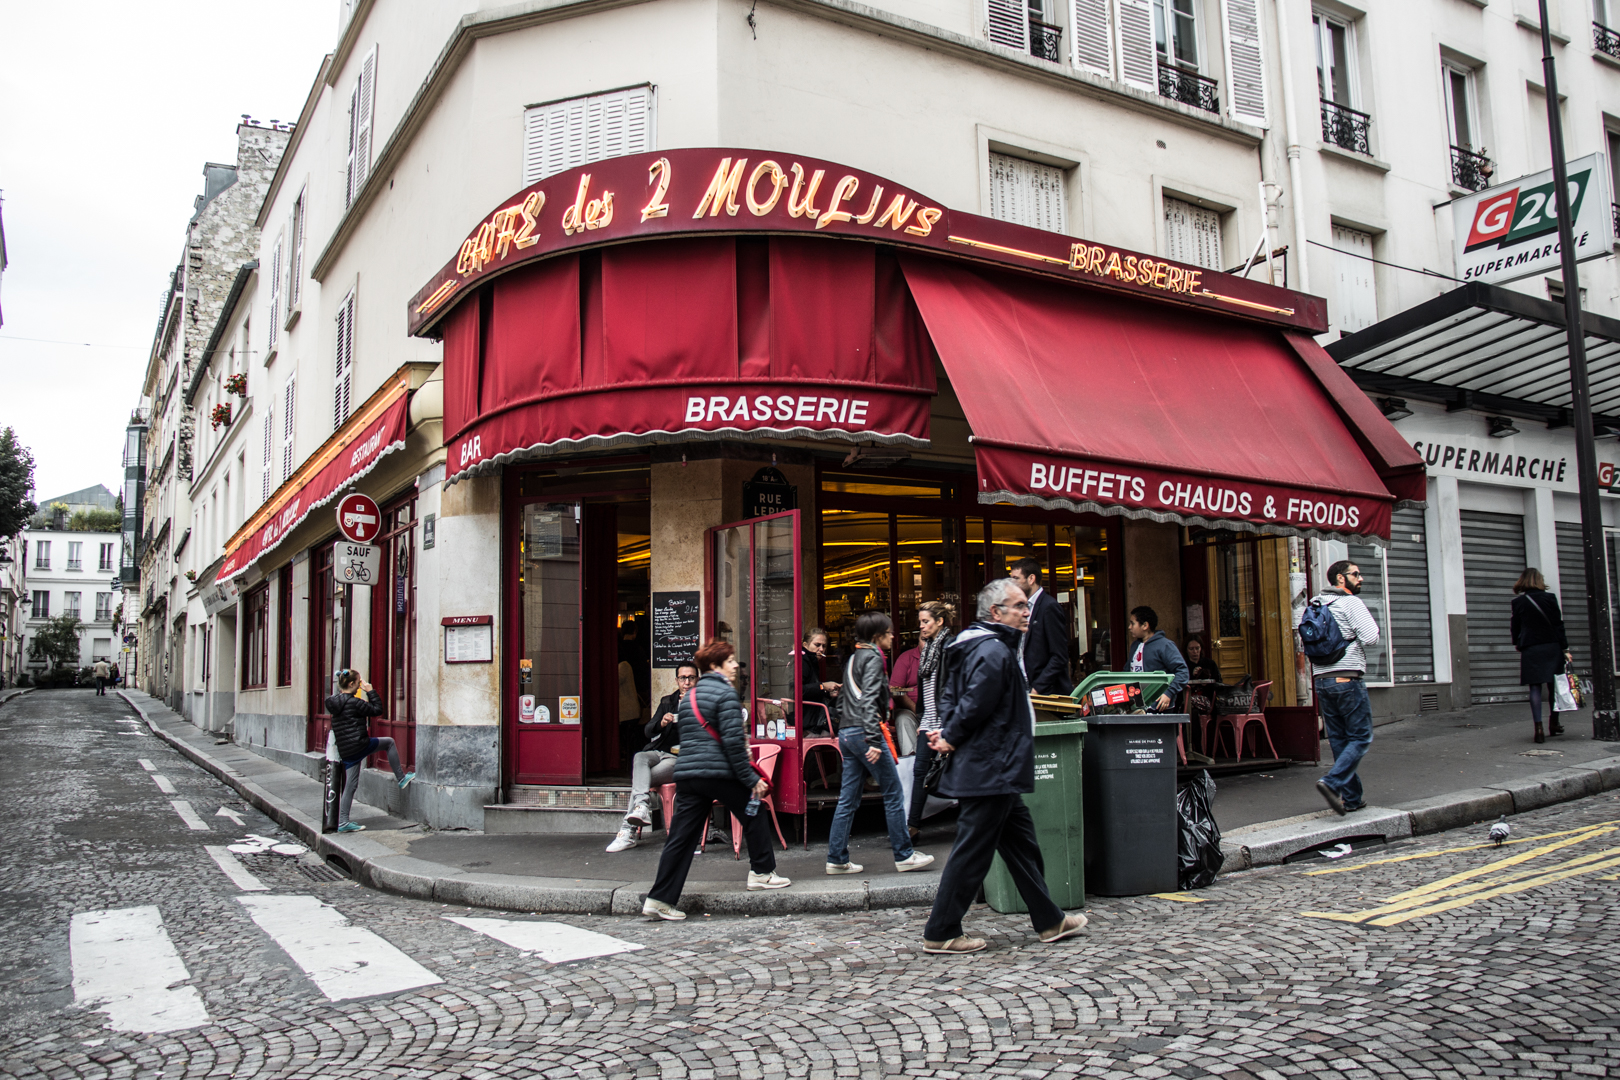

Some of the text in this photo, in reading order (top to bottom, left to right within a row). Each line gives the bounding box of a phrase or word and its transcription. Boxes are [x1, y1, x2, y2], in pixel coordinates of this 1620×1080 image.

[562, 173, 615, 237] des
[640, 156, 672, 223] 2
[692, 156, 943, 237] MOULINS
[1476, 180, 1580, 235] G20
[1068, 242, 1203, 297] BRASSERIE
[1464, 231, 1589, 280] SUPERMARCÉ
[685, 395, 870, 425] BRASSERIE
[460, 434, 482, 467] BAR
[759, 493, 782, 505] RUE
[1030, 462, 1360, 528] BUFFETS CHAUDS & FROIDS
[347, 546, 371, 557] SAUF
[452, 616, 479, 624] MENU
